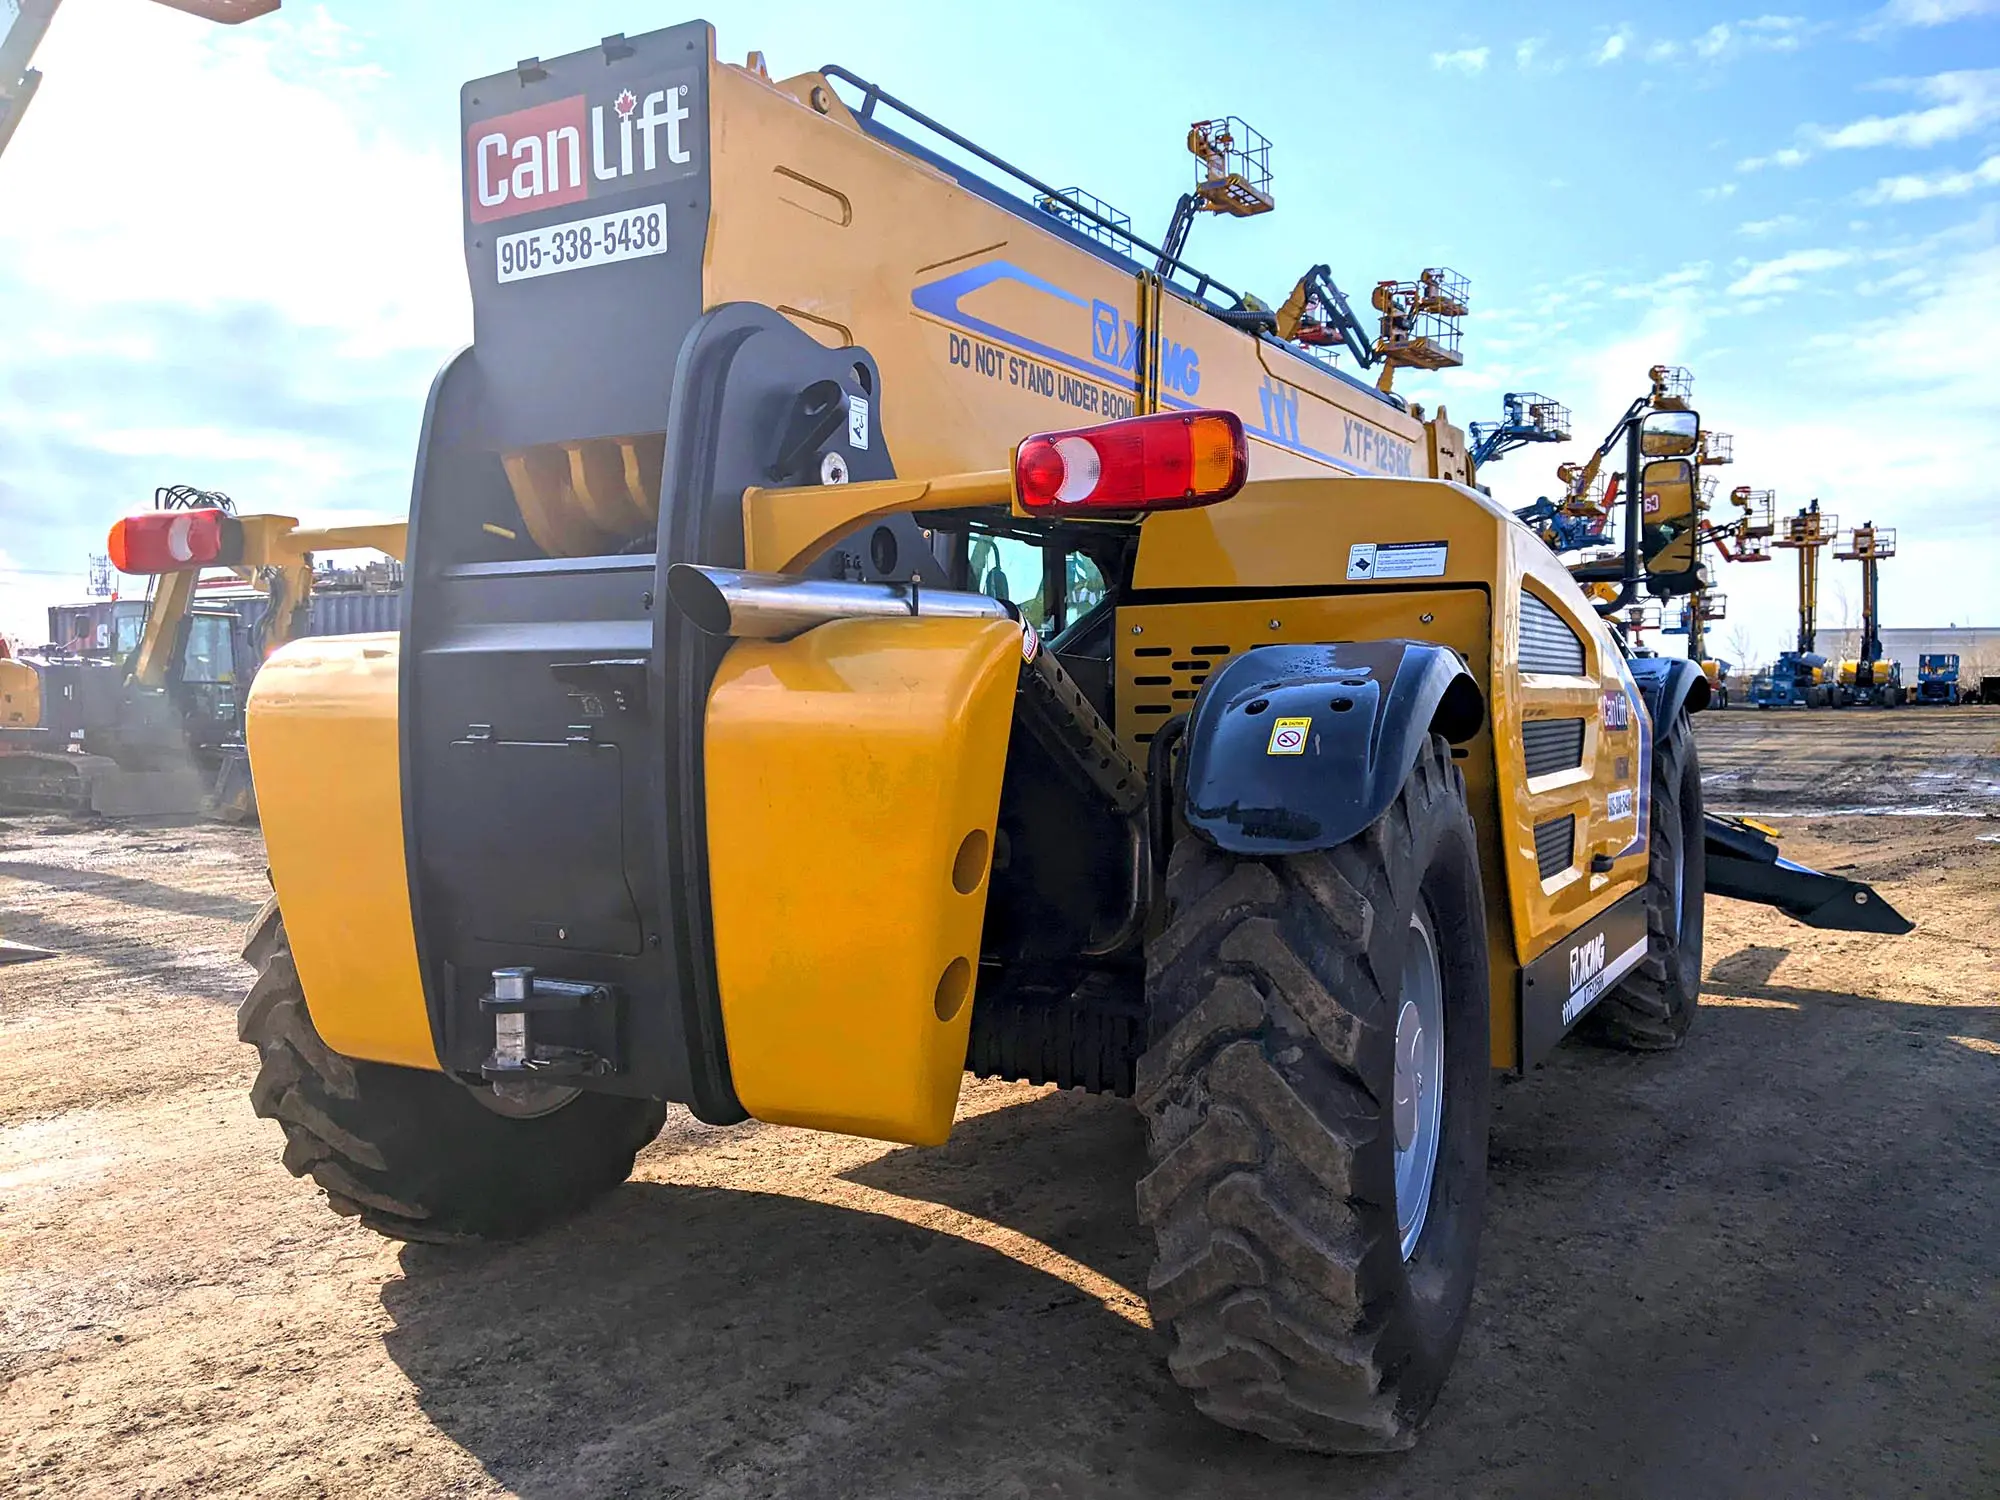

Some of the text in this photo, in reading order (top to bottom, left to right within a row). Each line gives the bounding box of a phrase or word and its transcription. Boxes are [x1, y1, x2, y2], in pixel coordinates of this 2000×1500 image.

[502, 213, 660, 274] 905-338-5438
[950, 333, 971, 369] DO
[975, 343, 1005, 380] NOT
[1009, 357, 1054, 398] STAND
[1058, 375, 1098, 413] UNDER
